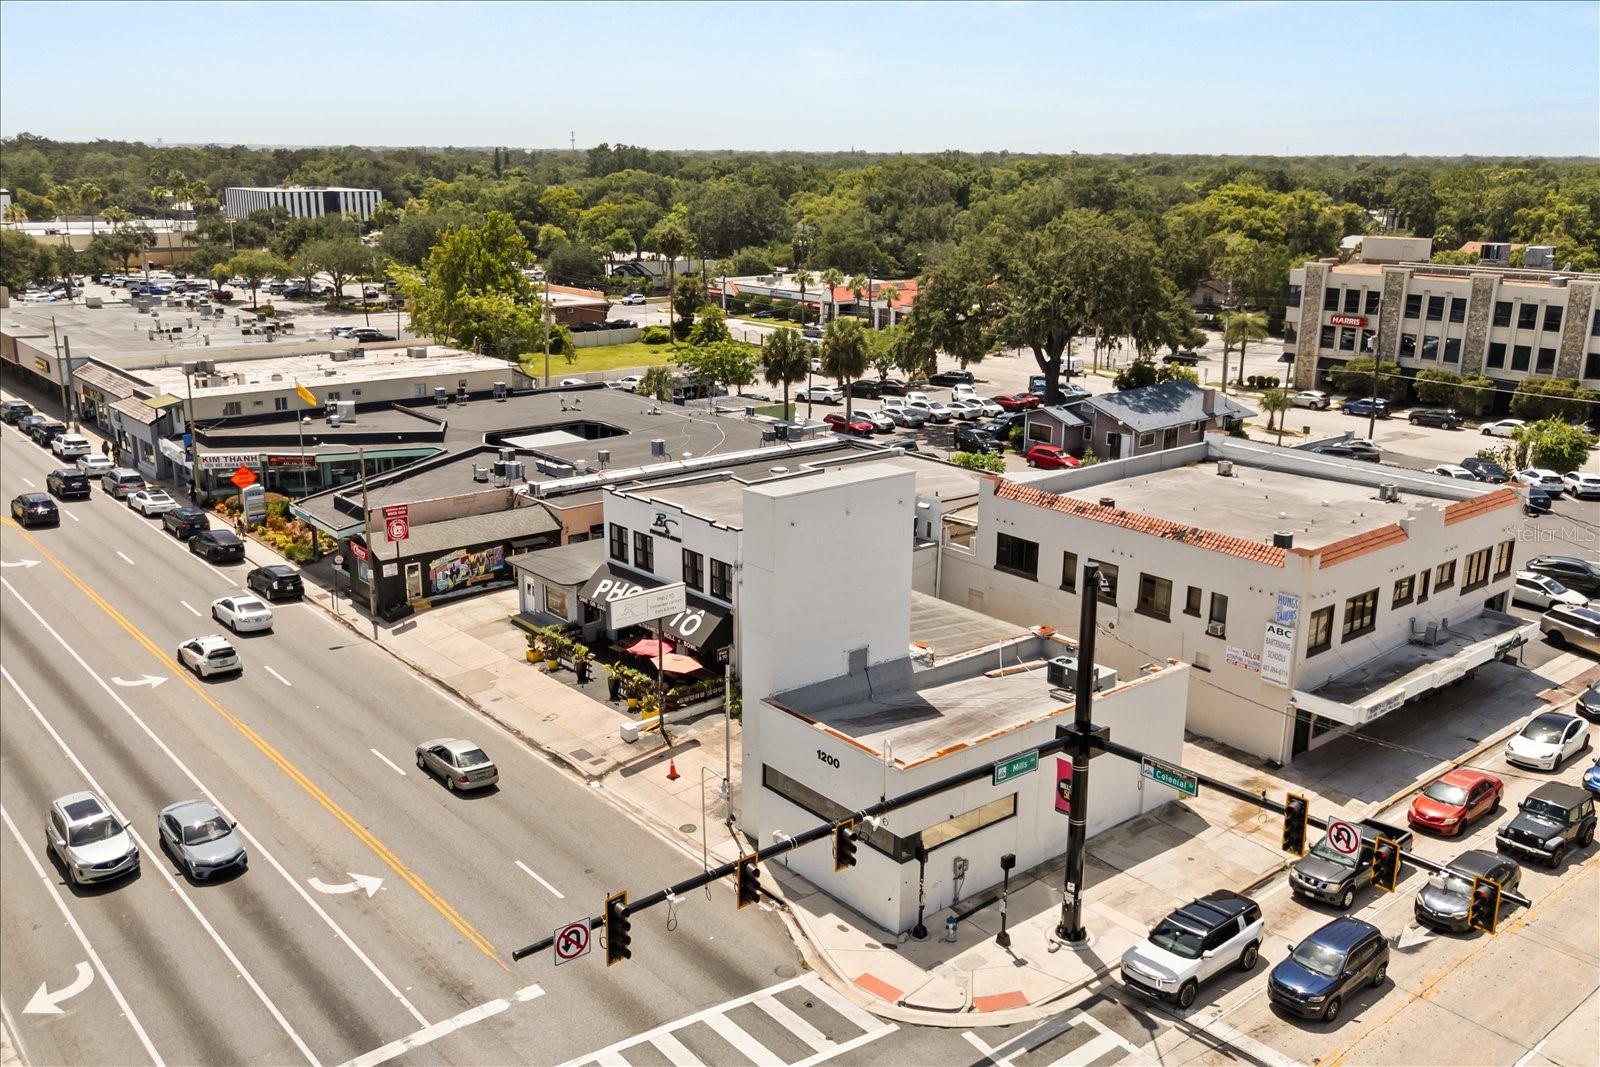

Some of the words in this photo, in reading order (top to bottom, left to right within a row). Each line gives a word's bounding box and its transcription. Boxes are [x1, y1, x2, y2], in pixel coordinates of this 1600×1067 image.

[1332, 316, 1361, 326] HARRIS
[224, 455, 258, 463] THANH
[1267, 625, 1293, 639] ABC
[1242, 650, 1260, 660] TAILOR
[817, 750, 840, 769] 1200
[1012, 761, 1028, 773] Mills
[1156, 770, 1187, 789] Colonial
